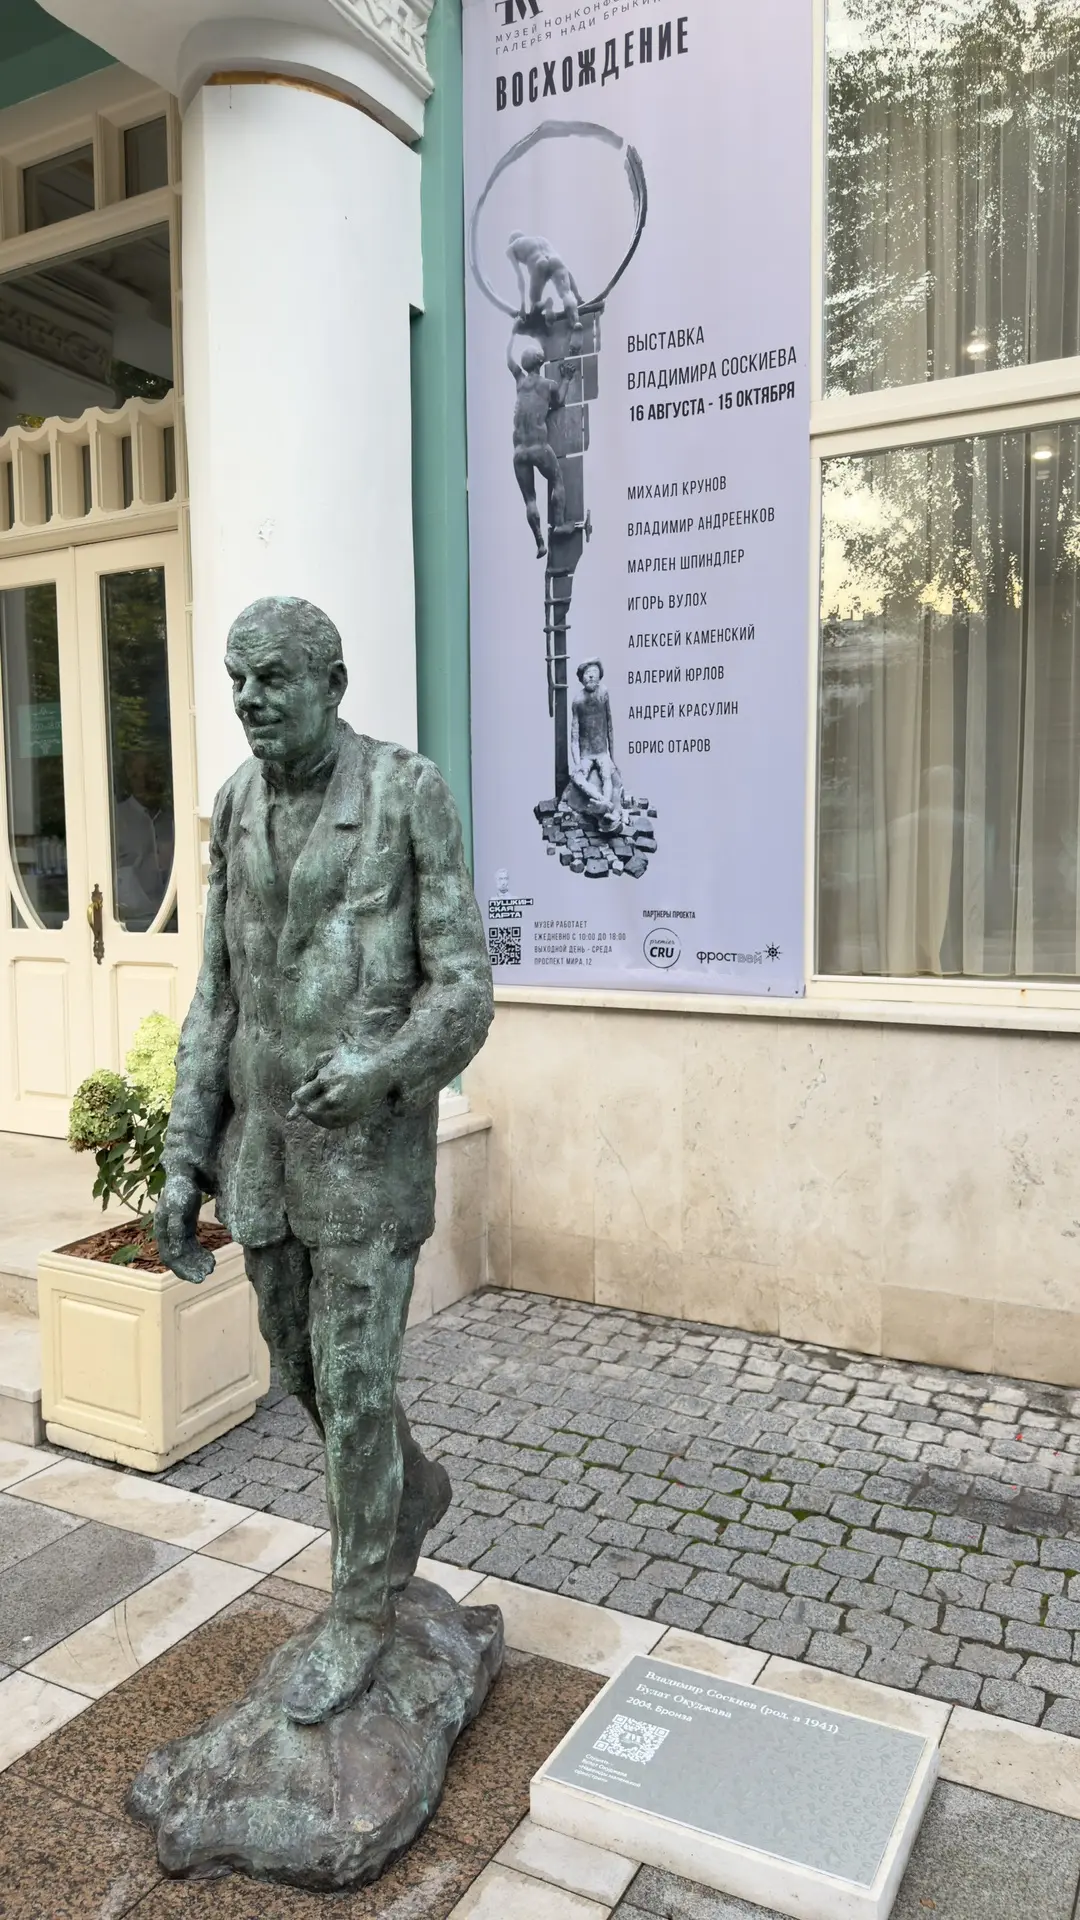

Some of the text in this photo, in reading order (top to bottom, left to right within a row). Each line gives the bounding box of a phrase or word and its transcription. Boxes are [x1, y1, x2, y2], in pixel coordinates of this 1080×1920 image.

[495, 24, 538, 43] МУЗЕЙ
[544, 0, 620, 28] НОНКОНФ
[495, 31, 552, 55] ГАЛЕРЕЯ
[560, 17, 596, 36] НАДИ
[496, 16, 689, 112] ВОСХОЖДЕНИЕ
[627, 326, 705, 353] ВЫСТАВКА
[627, 346, 797, 390] ВЛАДИМИРА СОСКИЕВА
[629, 405, 644, 422] 16
[647, 398, 705, 420] АВГУСТА
[718, 392, 733, 410] 15
[736, 381, 795, 407] ОКТЯБРЯ
[627, 476, 727, 500] МИХАИЛ КРУНОВ
[627, 507, 775, 537] ВЛАДИМИР АНДРЕЕНКОВ
[627, 549, 745, 574] МАРЛЕН ШПИНДЛЕР
[627, 592, 707, 611] ИГОРЬ ВУЛОХ
[628, 624, 755, 649] АЛЕКСЕЙ КАМЕНСКИЙ
[627, 665, 725, 684] ВАЛЕРИЙ ЮРЛОВ
[628, 701, 739, 720] АНДРЕЙ КРАСУЛИН
[628, 738, 711, 754] БОРИС ОТАРОВ
[534, 920, 588, 928] МУЗЕЙ РАБОТАЕТ
[643, 910, 696, 920] ПАРТНЕРЫ ПРОЕКТА
[568, 945, 586, 953] ДЕНЬ
[591, 945, 613, 953] СРЕДА
[649, 946, 674, 958] CRU
[636, 1683, 732, 1719] Булат Окуджава
[645, 1671, 704, 1695] Владимир
[706, 1689, 757, 1710] Соскиев
[804, 1717, 839, 1734] 1941)
[654, 1705, 693, 1722] Бронза
